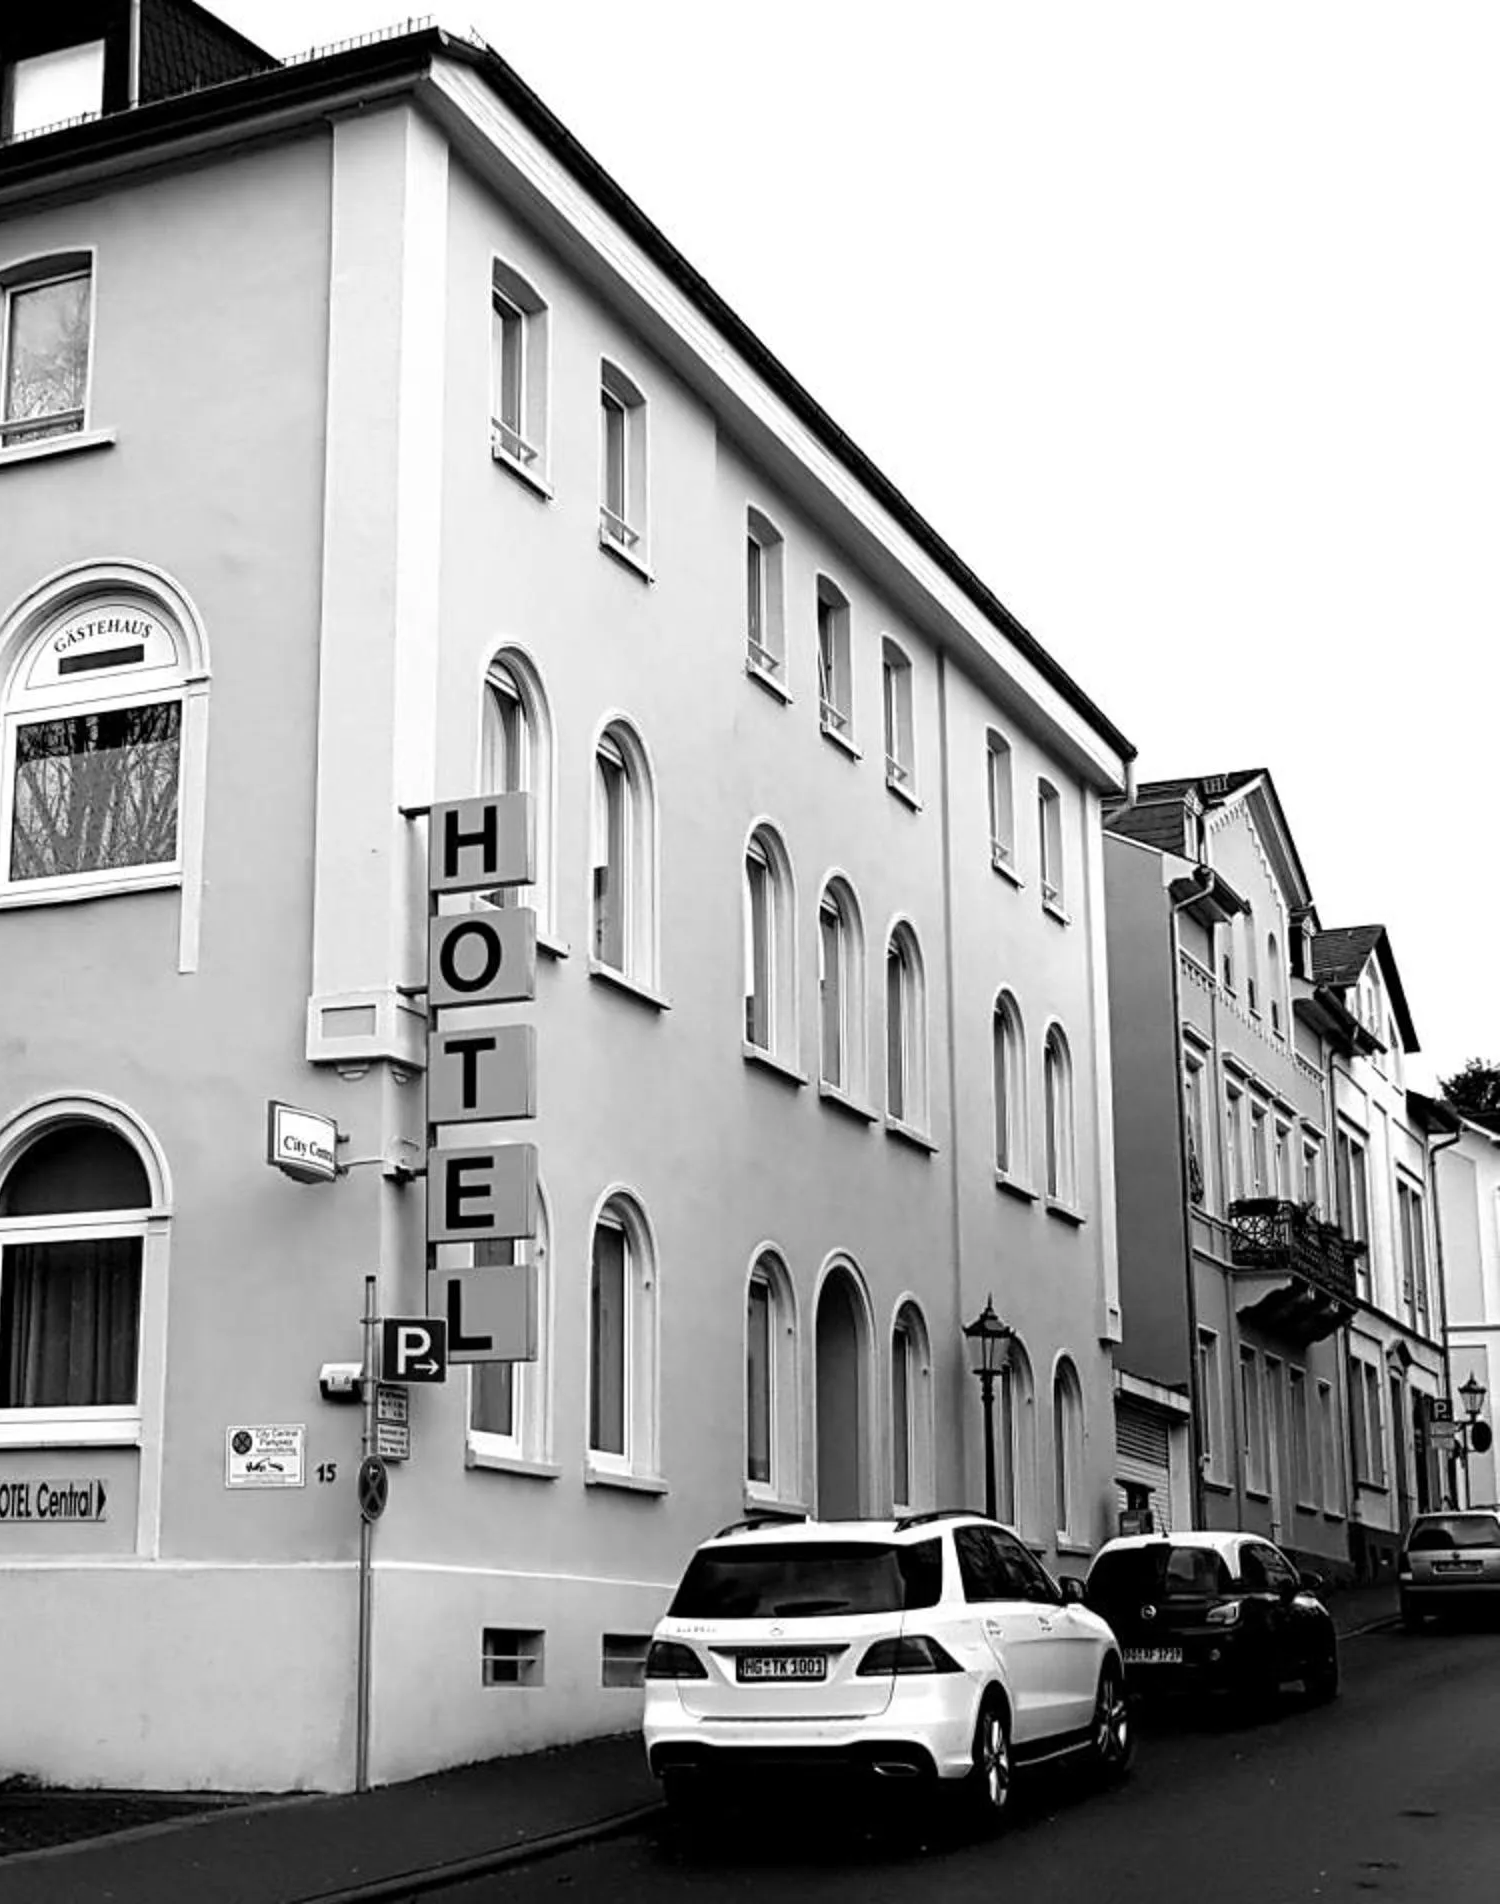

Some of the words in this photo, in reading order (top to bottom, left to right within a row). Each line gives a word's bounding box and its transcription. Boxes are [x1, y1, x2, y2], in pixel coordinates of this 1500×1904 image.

[53, 619, 152, 653] GÄSTEHAUS
[440, 805, 502, 1352] HOTEL
[283, 1135, 307, 1156] City
[397, 1326, 431, 1375] P
[1434, 1401, 1447, 1418] P
[316, 1463, 337, 1483] 15
[37, 1482, 93, 1518] Central
